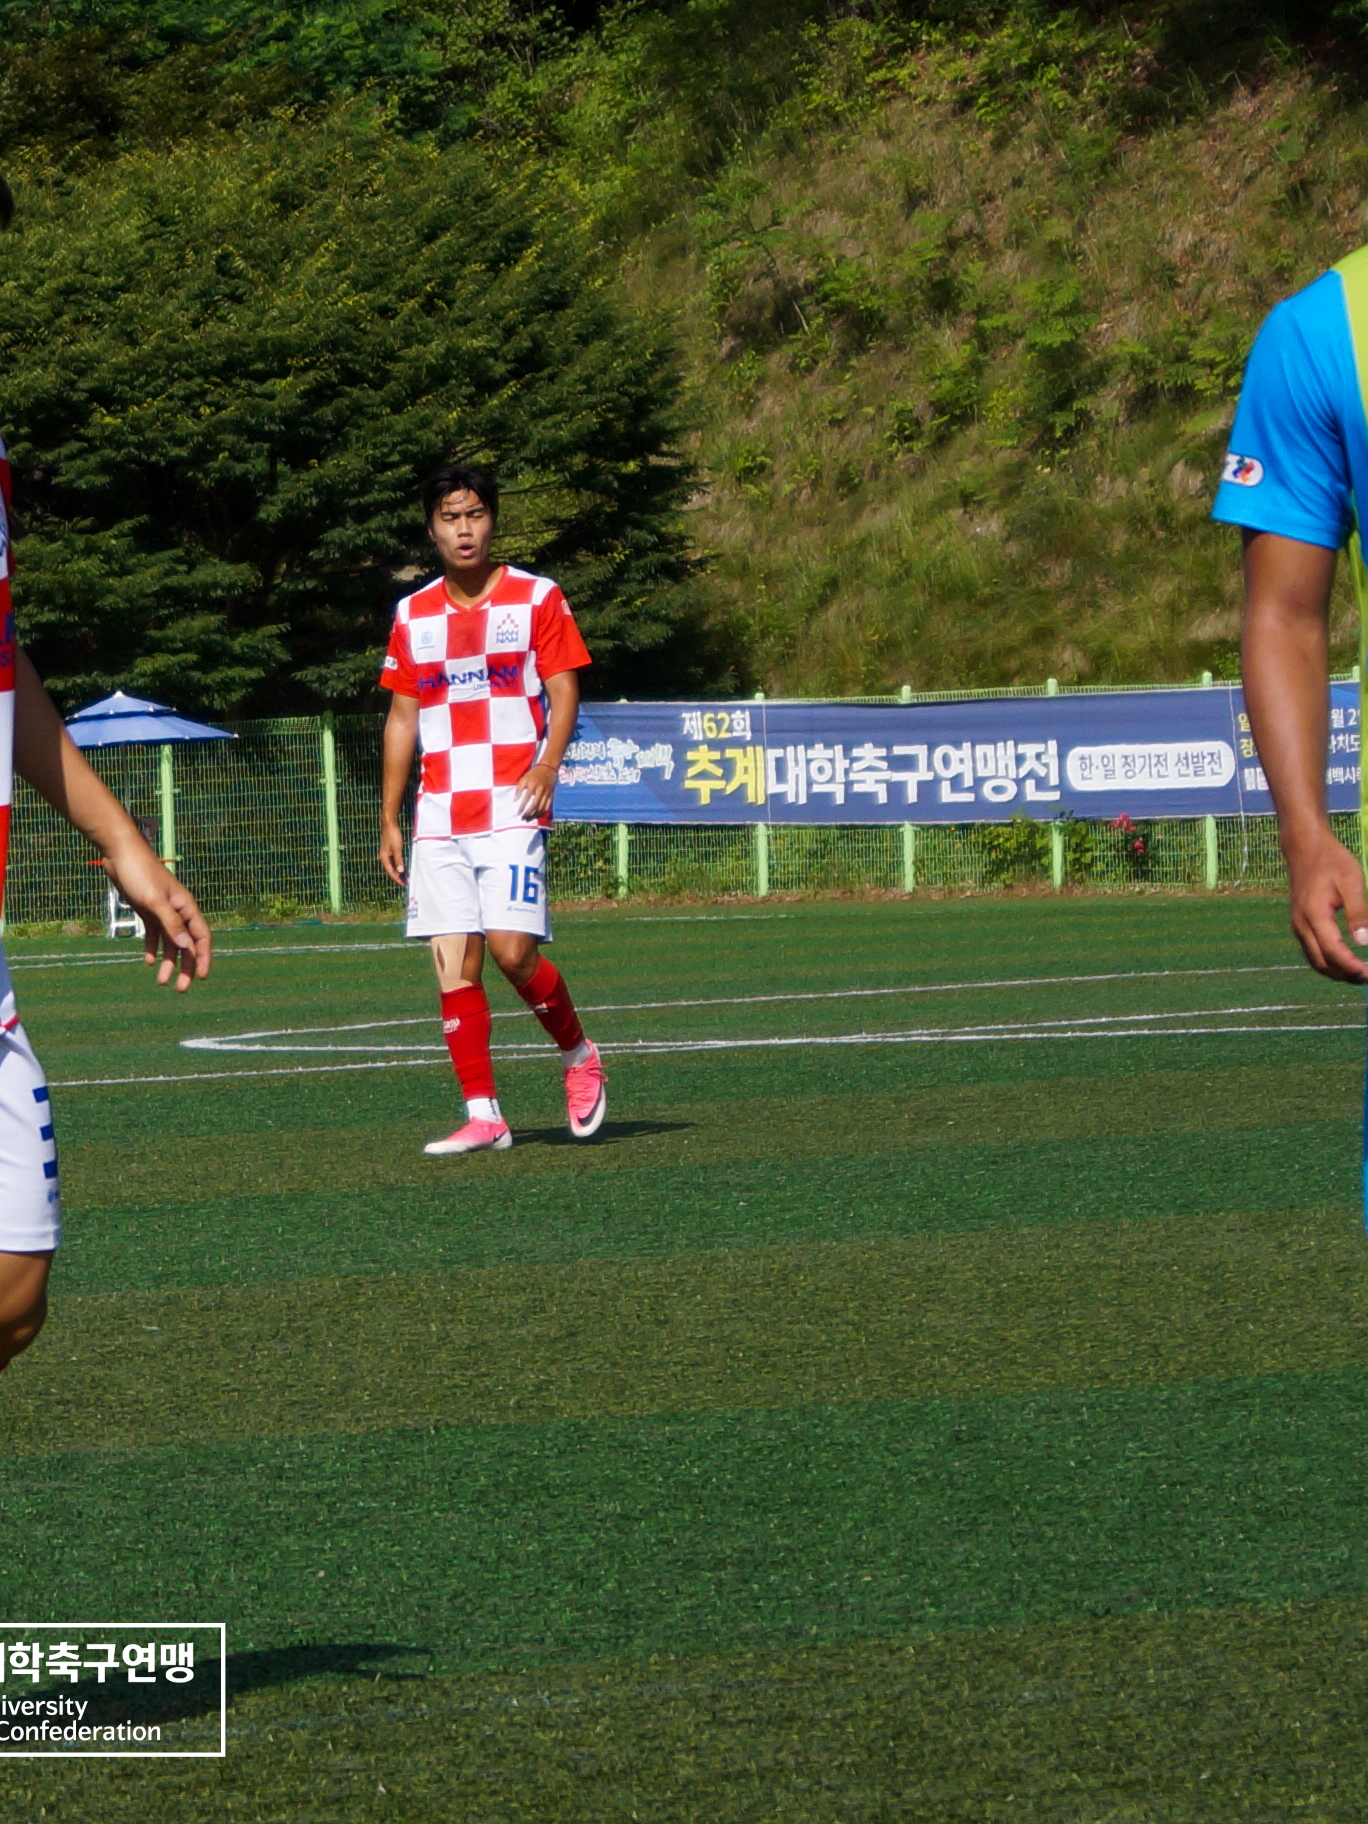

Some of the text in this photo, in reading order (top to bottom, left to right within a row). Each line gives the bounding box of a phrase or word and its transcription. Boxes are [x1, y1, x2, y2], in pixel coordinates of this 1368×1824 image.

[417, 665, 519, 690] HANNAM
[682, 710, 751, 740] 제62회
[684, 741, 1061, 805] 추계대학축구연맹전
[1121, 752, 1169, 779] 정기전
[1174, 749, 1224, 777] 선발전
[509, 864, 539, 904] 16
